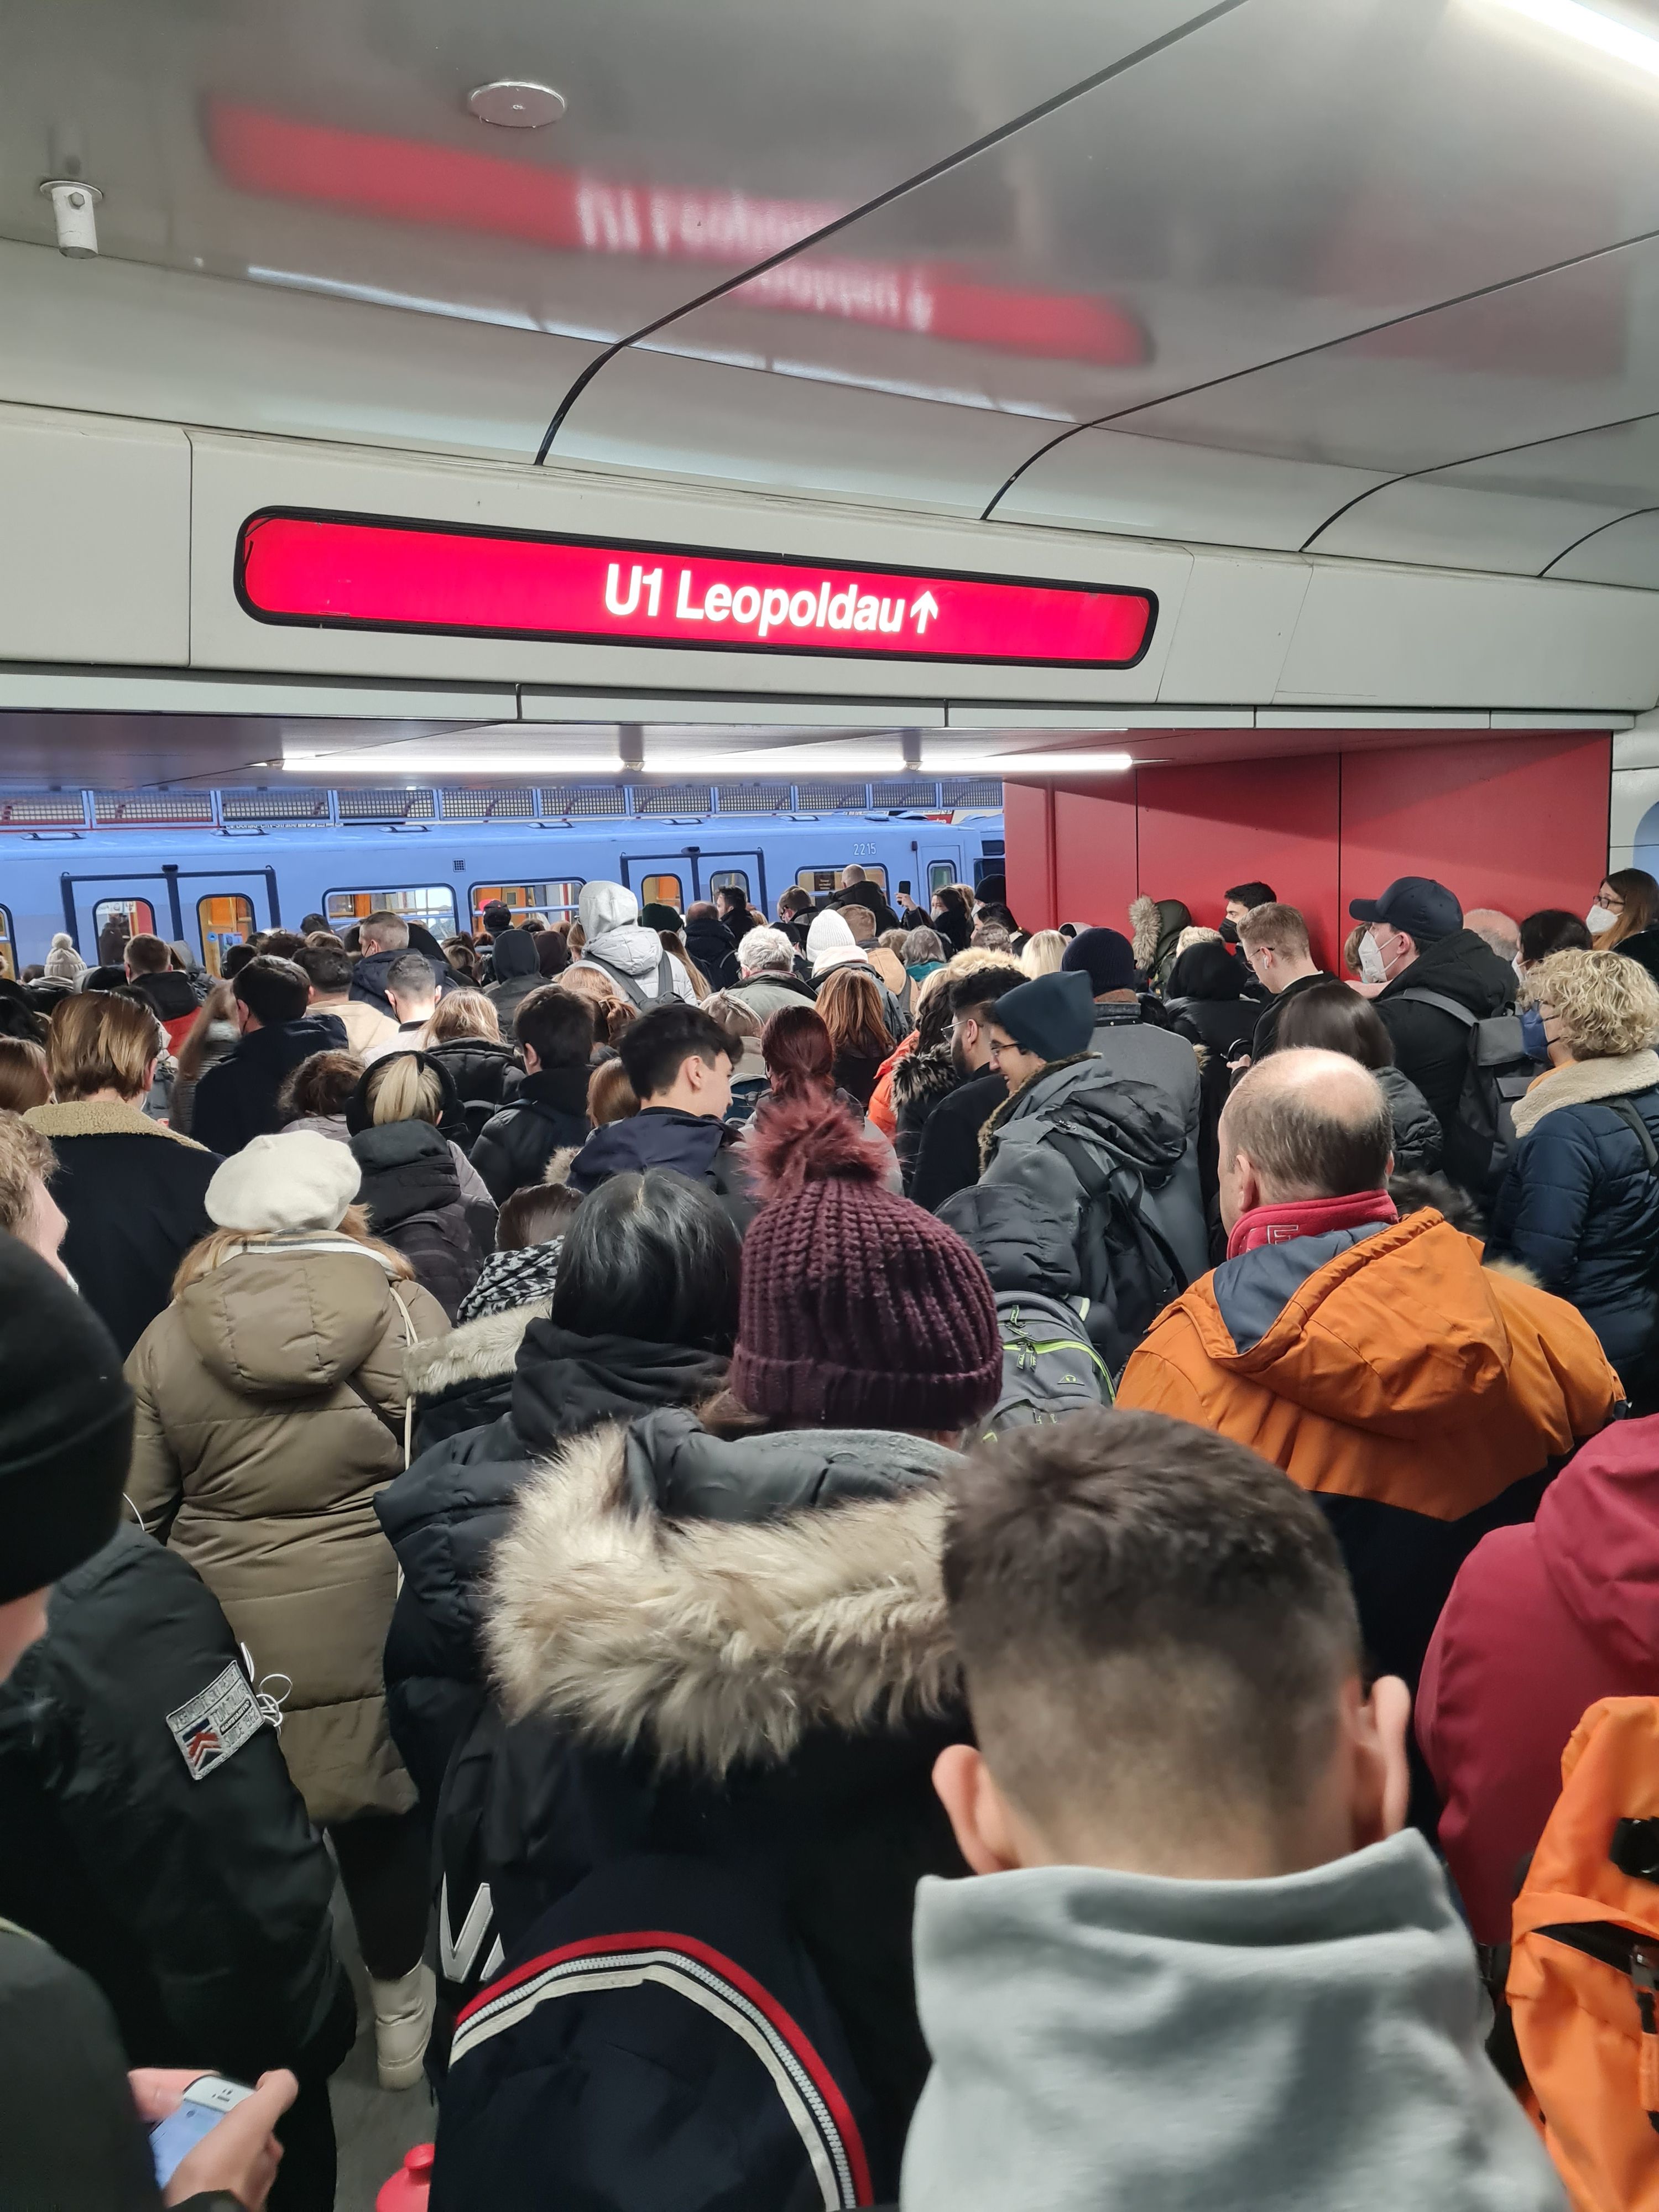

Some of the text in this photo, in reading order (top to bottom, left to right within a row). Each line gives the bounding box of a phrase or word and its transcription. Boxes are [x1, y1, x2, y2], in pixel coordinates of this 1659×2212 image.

[604, 563, 906, 637] U1 Leopoldau
[853, 843, 877, 855] 2215
